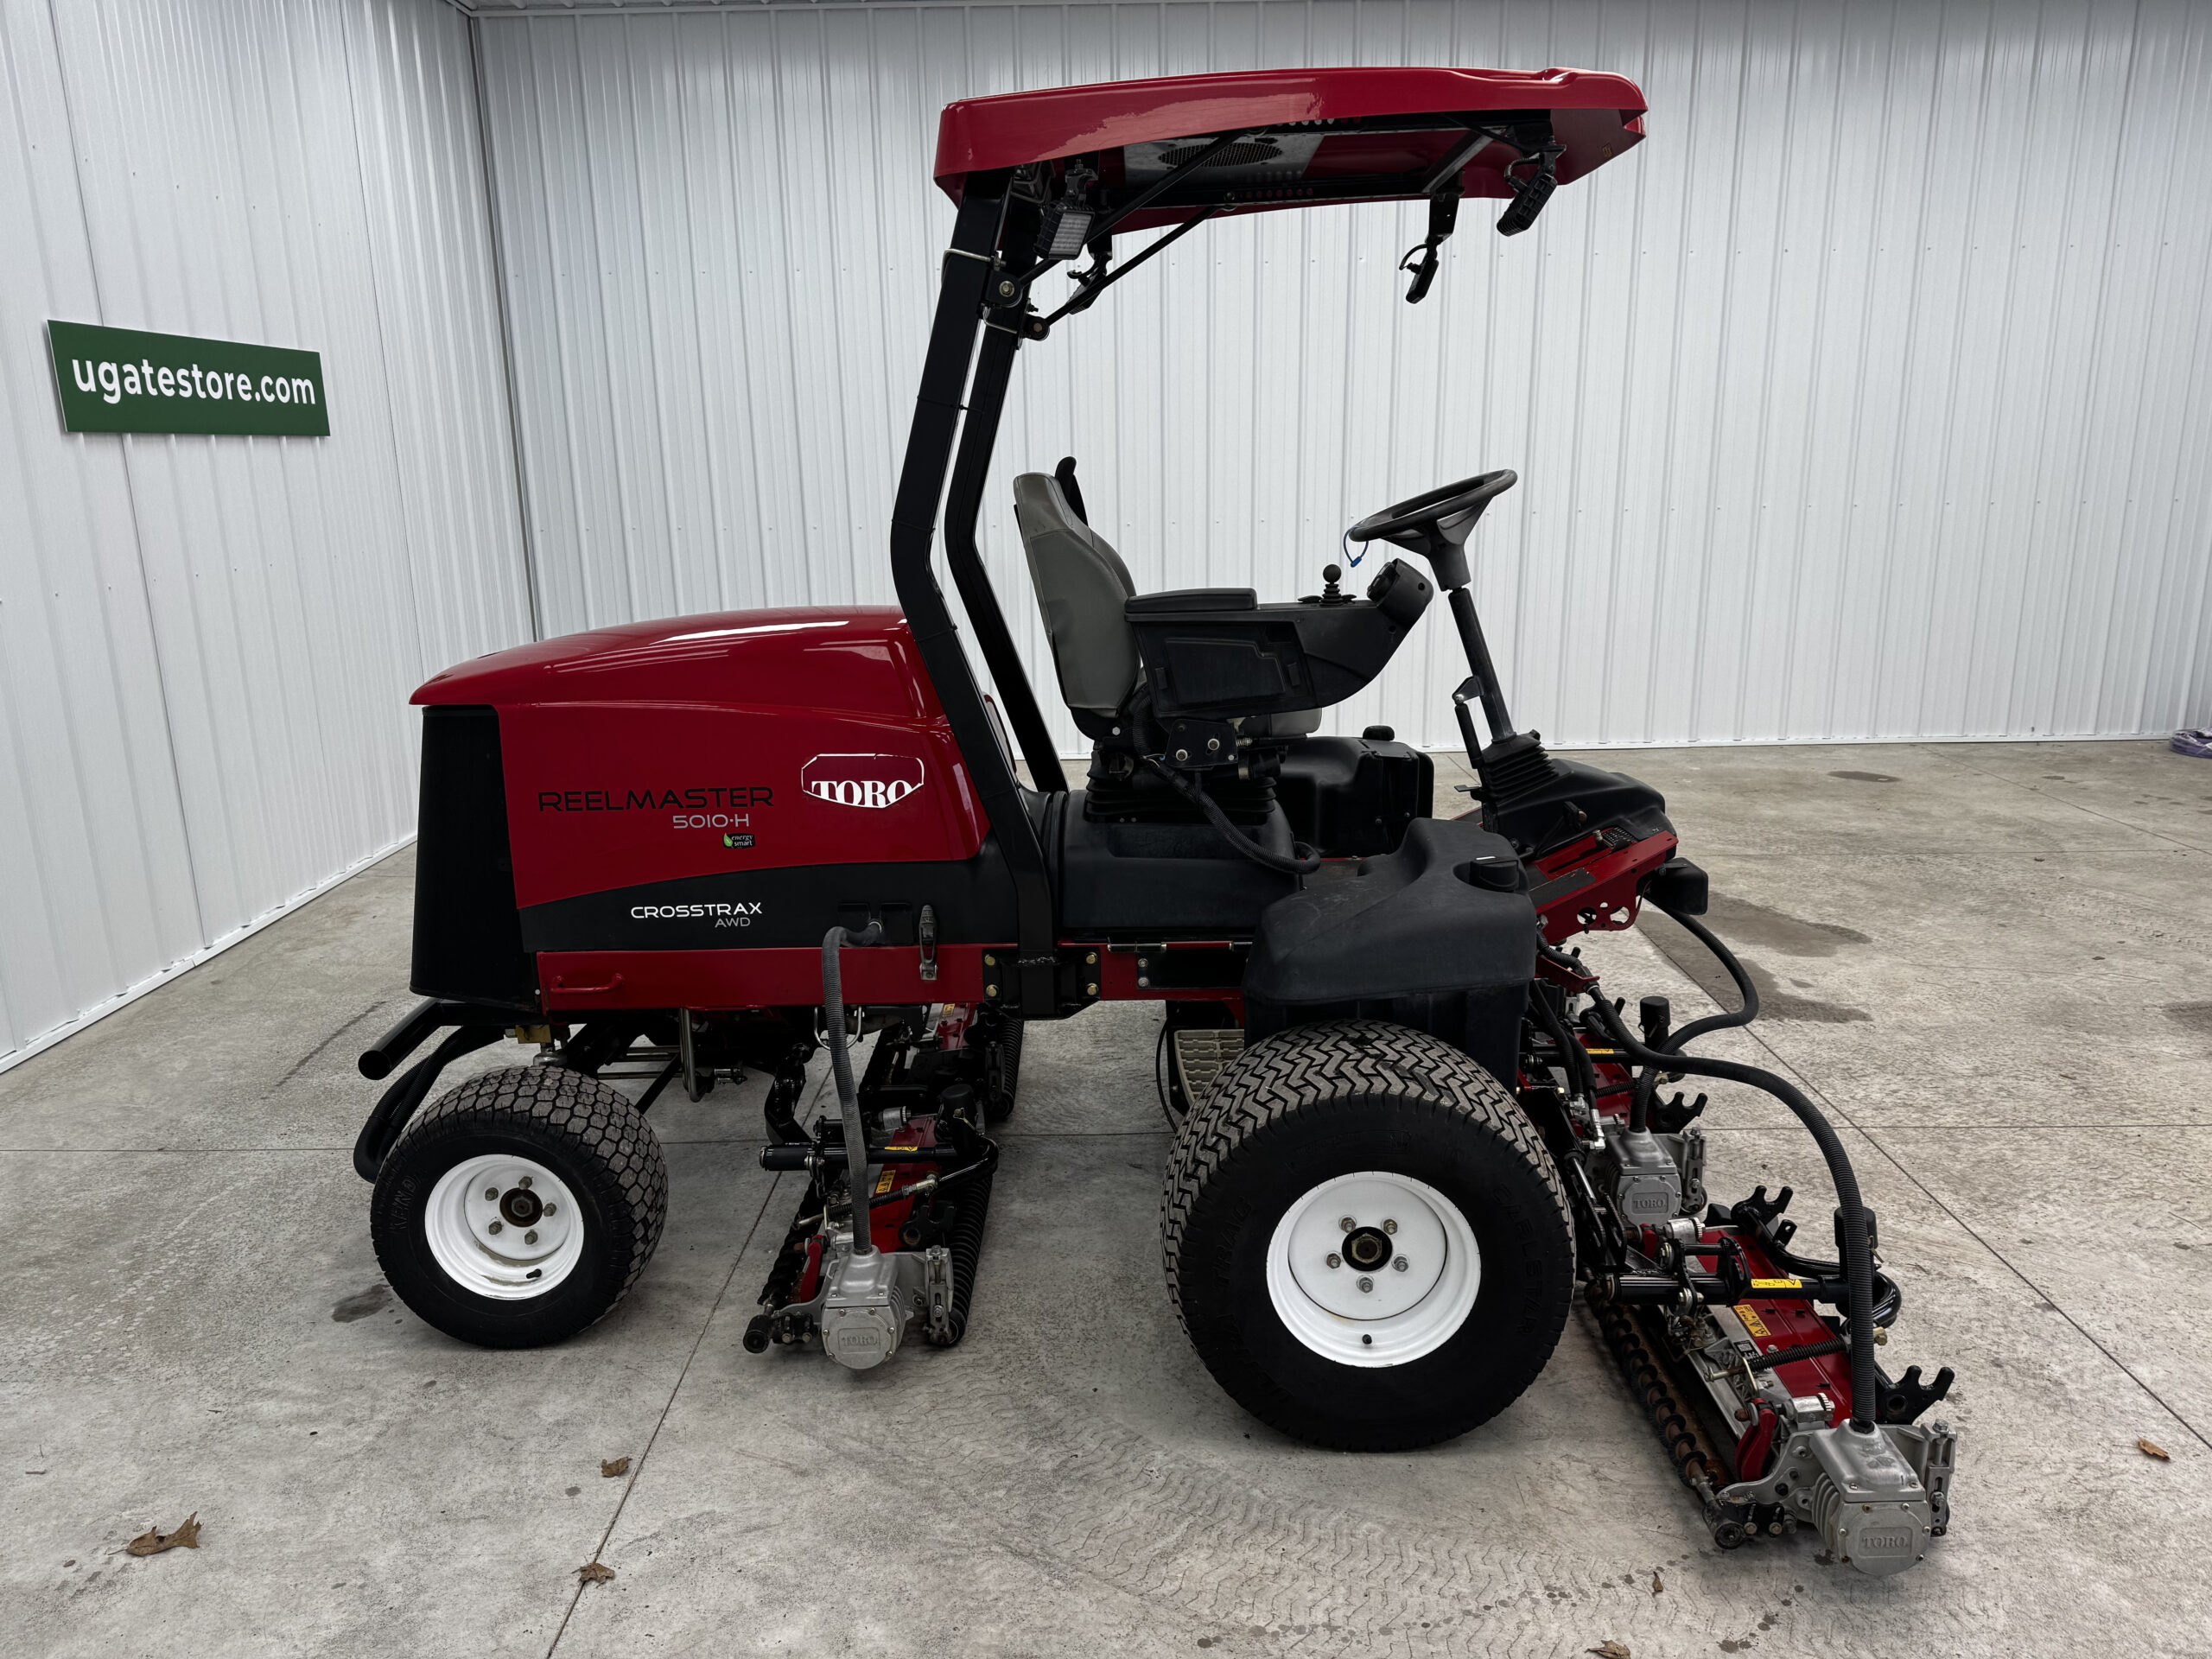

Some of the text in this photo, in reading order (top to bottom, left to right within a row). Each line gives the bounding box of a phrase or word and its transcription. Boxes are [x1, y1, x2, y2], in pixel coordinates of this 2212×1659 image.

[72, 359, 316, 404] ugatestore.com
[538, 786, 773, 812] REELMASTER
[811, 779, 913, 809] TORO
[631, 902, 762, 918] CROSSTRAX
[715, 917, 751, 928] AWD
[1633, 1198, 1667, 1210] TORO
[1491, 1183, 1542, 1335] CARLSTAR
[842, 1335, 878, 1346] TORO
[1862, 1536, 1909, 1548] TORO
